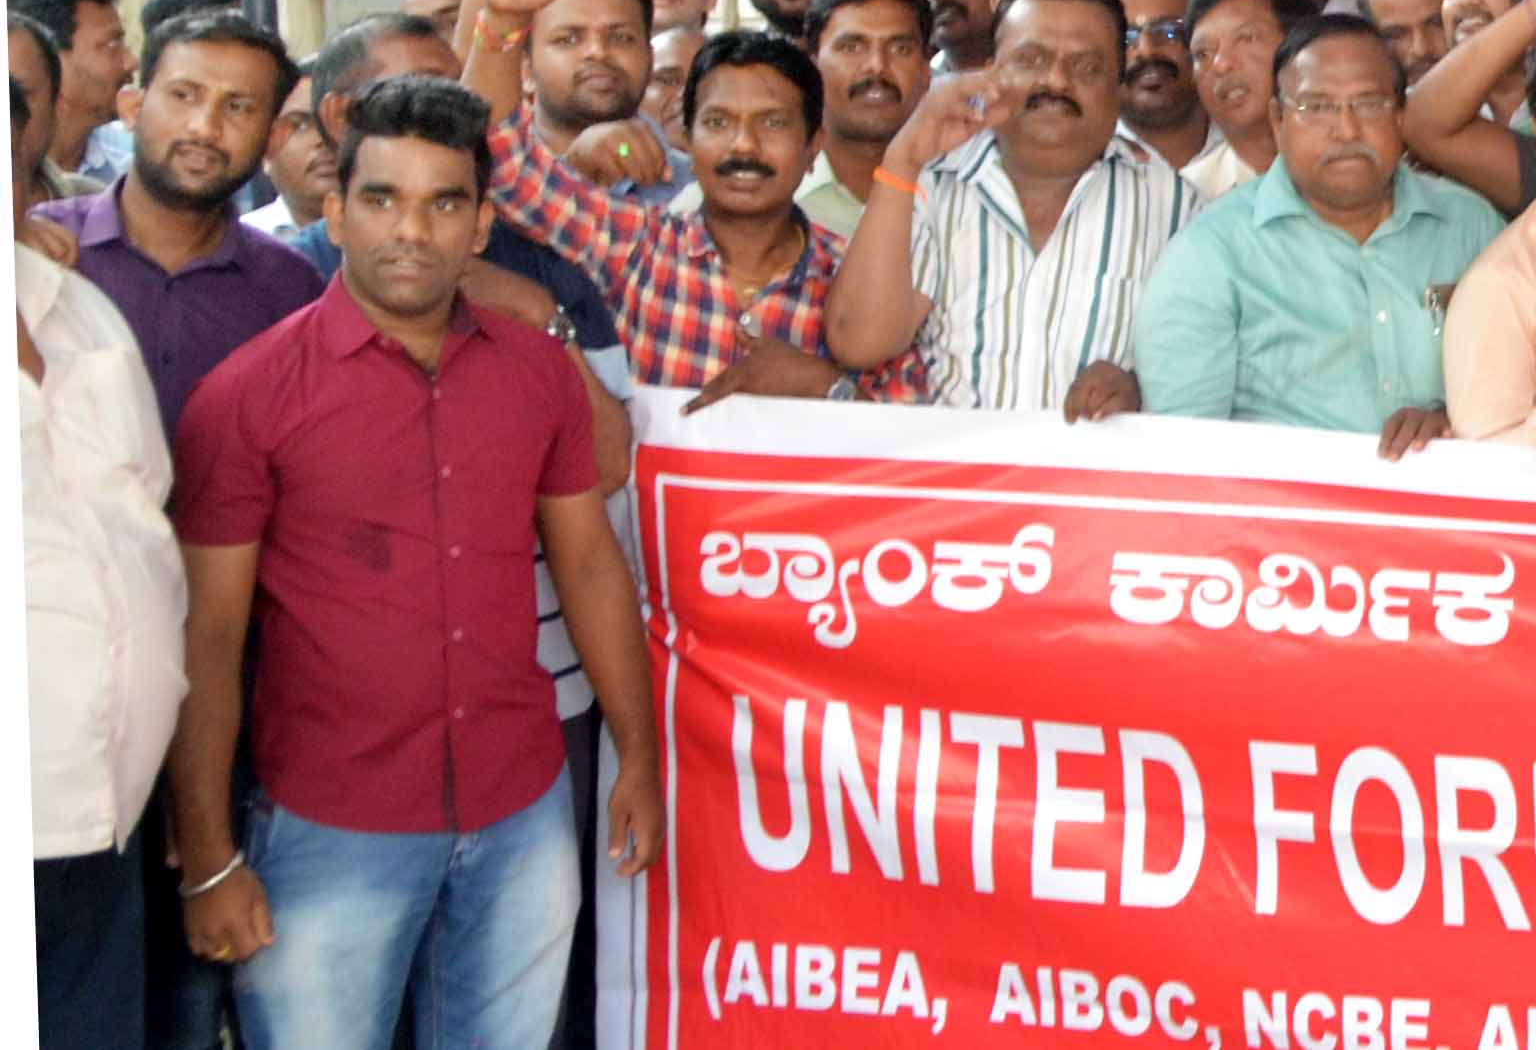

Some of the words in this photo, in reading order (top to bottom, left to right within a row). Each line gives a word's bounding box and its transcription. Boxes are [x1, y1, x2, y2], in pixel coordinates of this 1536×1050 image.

[699, 522, 1056, 649] ಬ್ಯಾಂಕ್
[1108, 549, 1516, 647] ಕಾರ್ಮಿಕ
[731, 695, 1207, 909] UNITED
[702, 937, 948, 1035] (AIBEA,
[990, 963, 1221, 1050] AIBOC,
[1242, 988, 1451, 1050] NCBE
